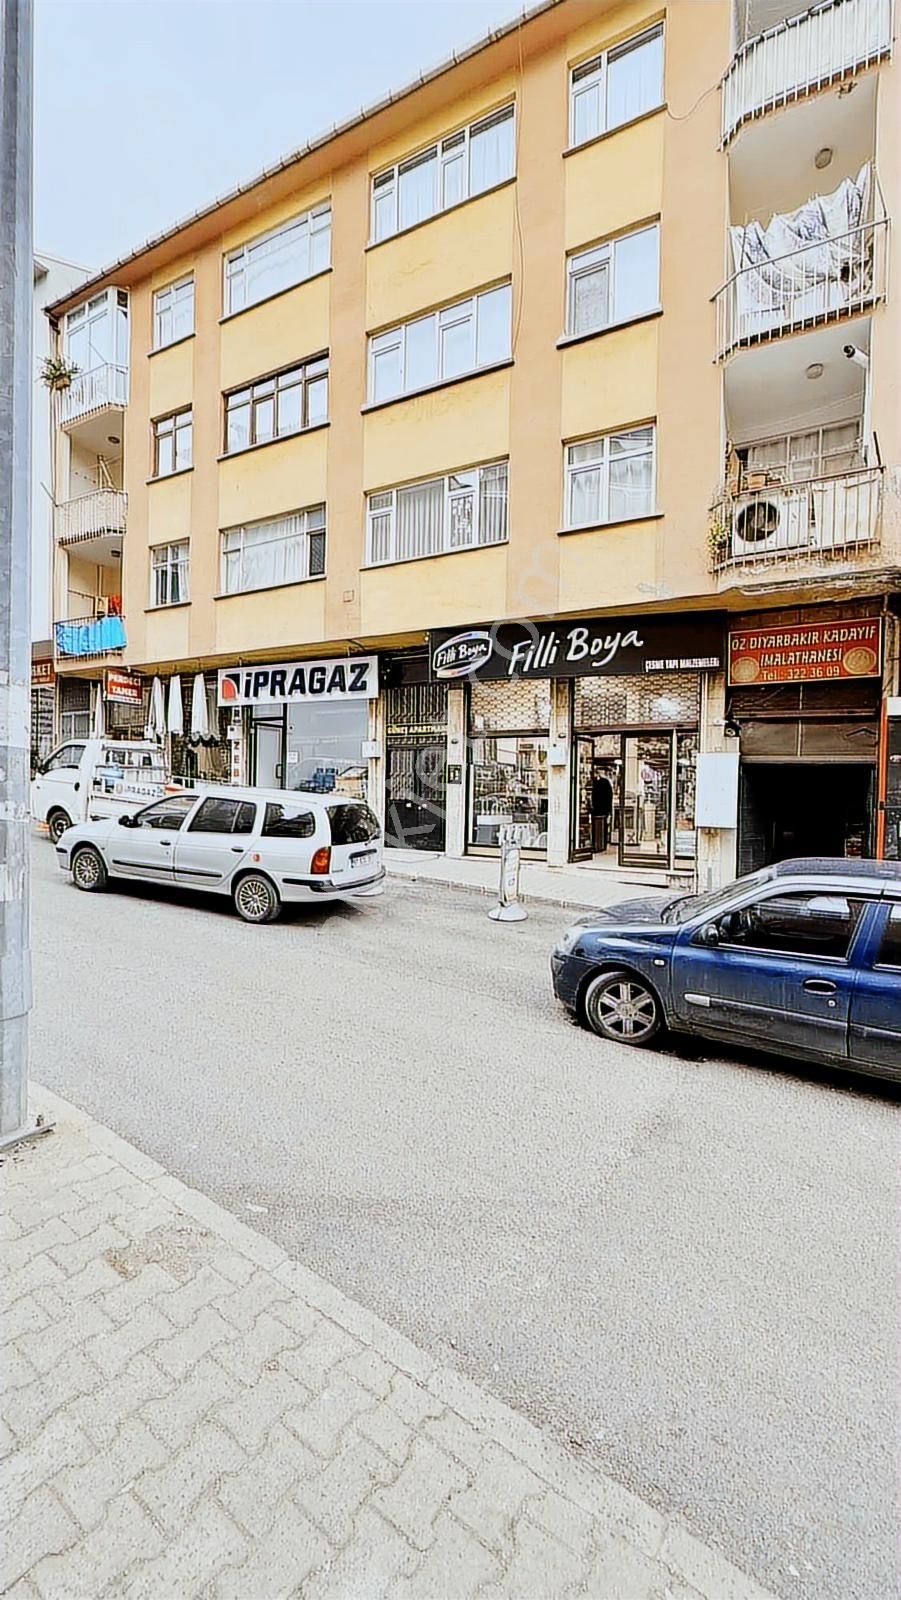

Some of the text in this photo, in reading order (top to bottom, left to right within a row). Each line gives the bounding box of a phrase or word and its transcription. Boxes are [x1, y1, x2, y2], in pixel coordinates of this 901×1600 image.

[823, 625, 877, 642] KADAYIF
[436, 642, 488, 668] Filli Boya
[508, 627, 644, 675] Filli Boya
[787, 667, 807, 680] 322
[810, 666, 823, 679] 36
[826, 665, 840, 677] 09
